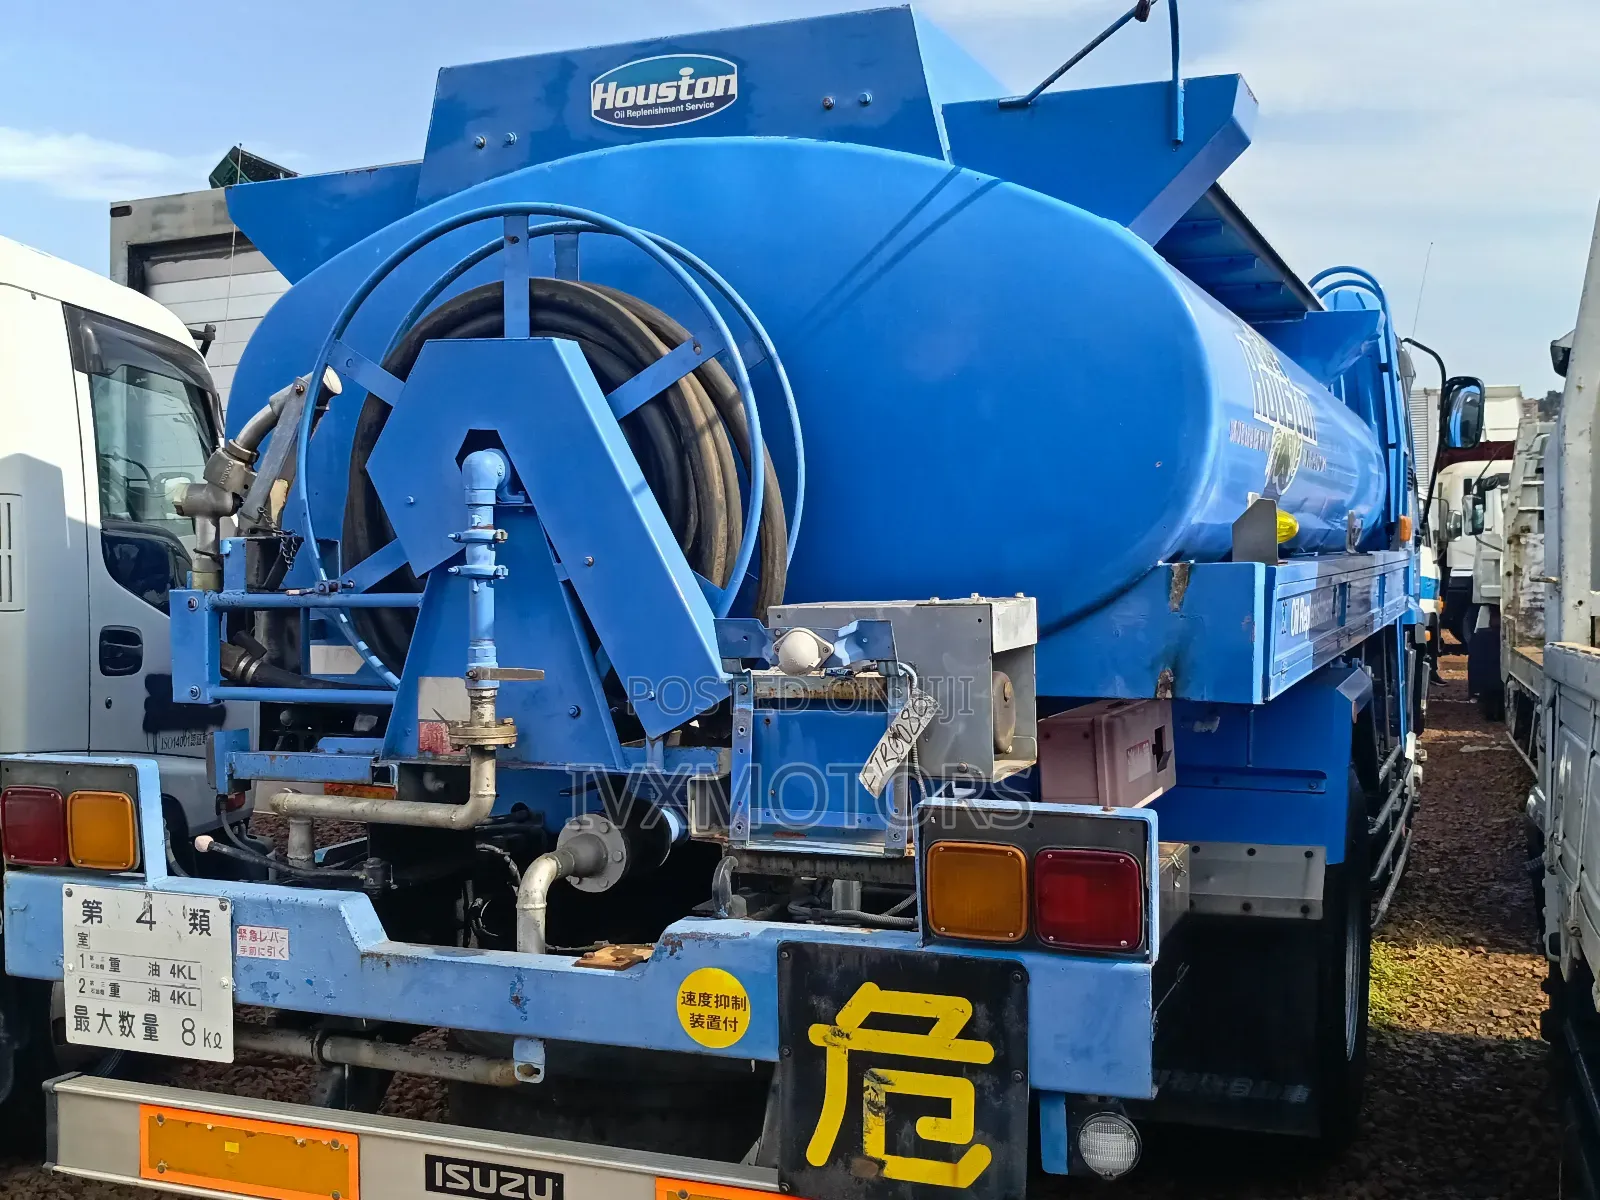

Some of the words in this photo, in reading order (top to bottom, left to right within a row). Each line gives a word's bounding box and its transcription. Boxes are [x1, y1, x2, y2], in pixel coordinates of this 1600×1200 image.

[593, 66, 736, 111] Houston
[614, 110, 625, 119] Oil
[626, 104, 684, 119] Replenishment
[685, 101, 715, 112] Service
[77, 931, 90, 948] 室
[240, 945, 286, 958] 手前に引く
[79, 953, 85, 969] 1
[169, 966, 197, 981] 4KL
[78, 977, 86, 994] 2
[169, 991, 197, 1007] 4KL
[681, 990, 747, 1012] 速度抑制
[74, 1004, 159, 1042] 最大数量
[689, 1012, 739, 1033] 装置付
[806, 981, 995, 1189] 危
[435, 1161, 553, 1200] ISUZU
